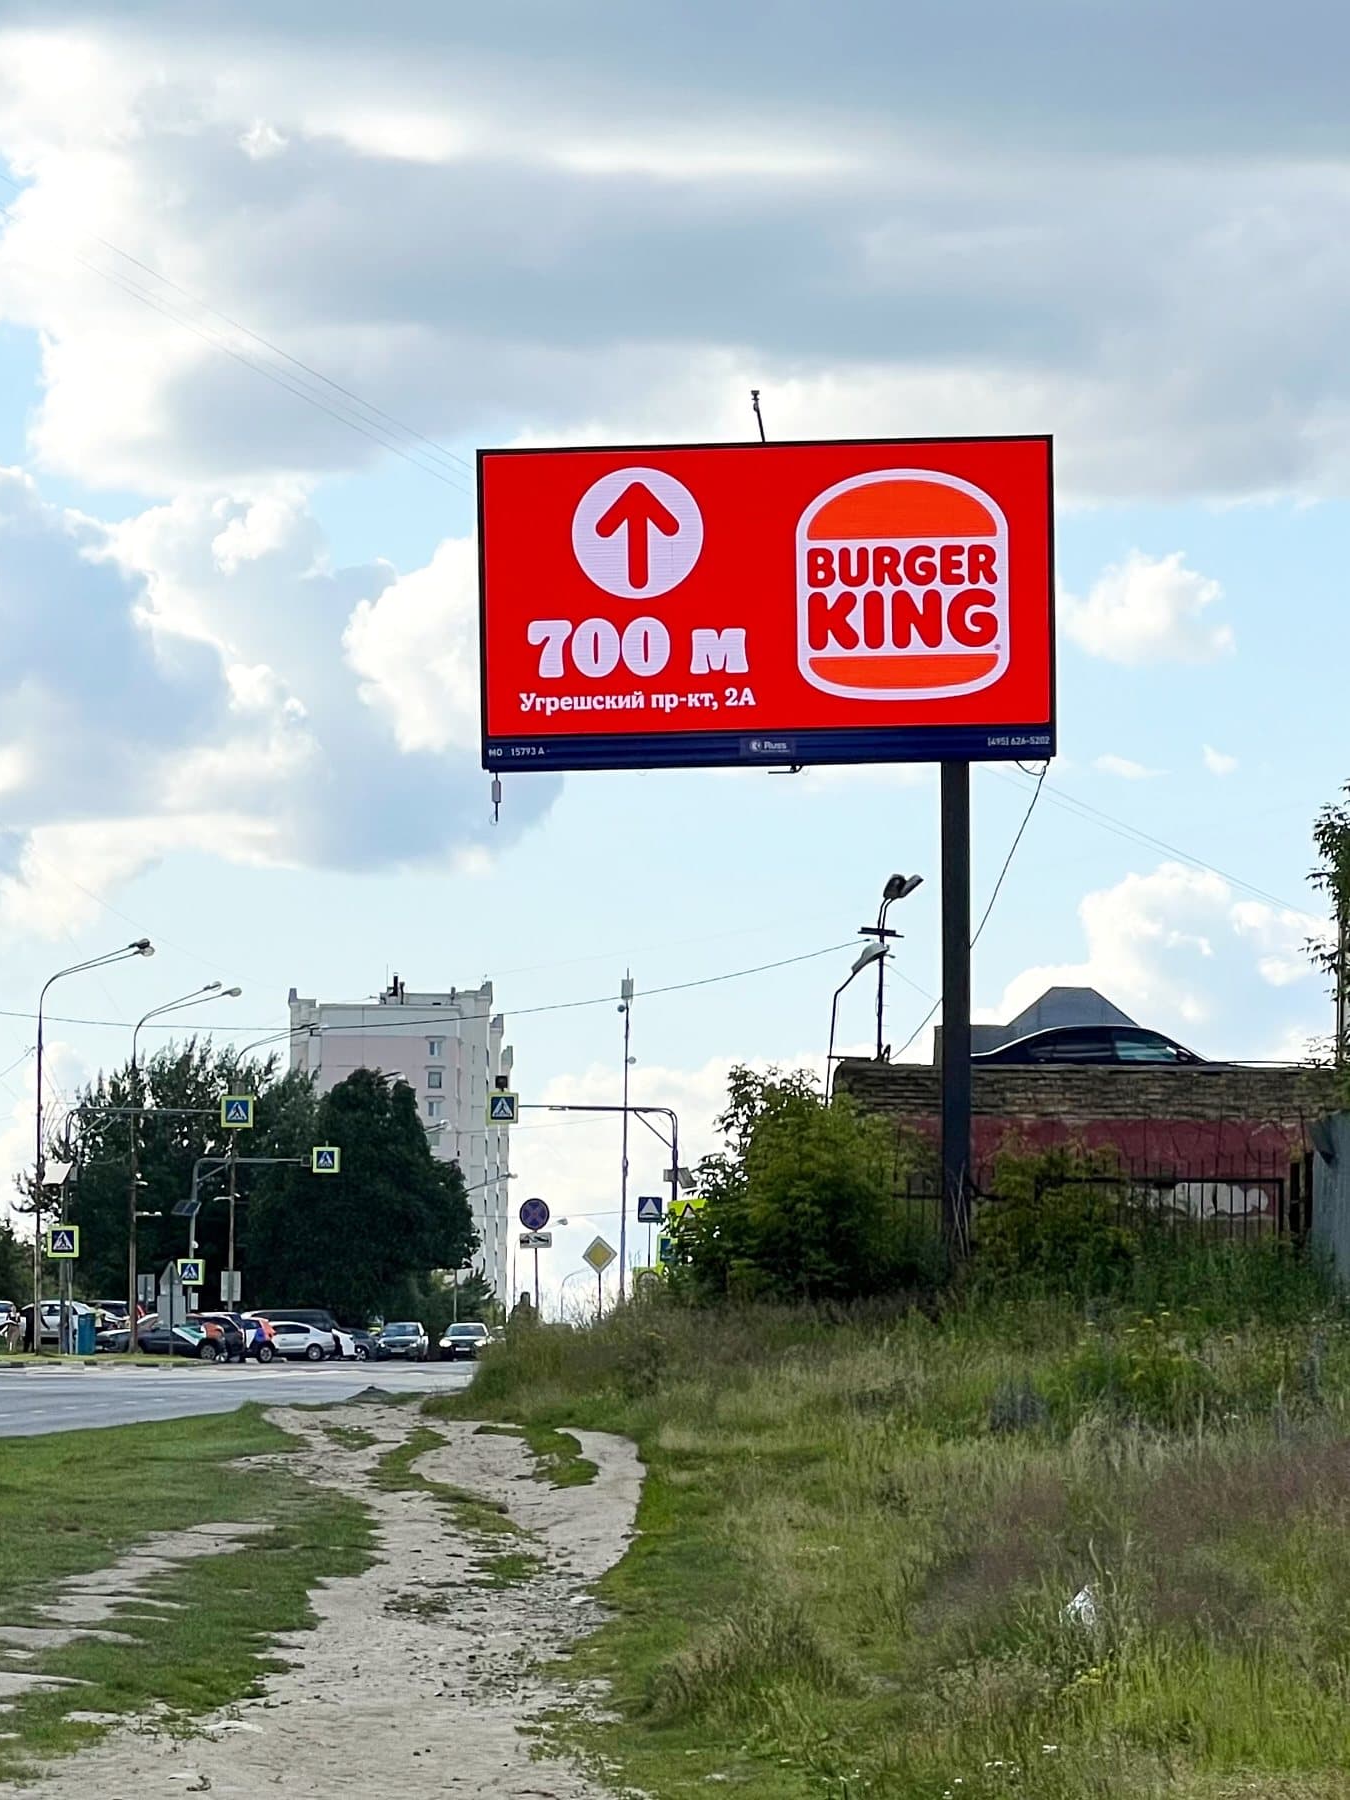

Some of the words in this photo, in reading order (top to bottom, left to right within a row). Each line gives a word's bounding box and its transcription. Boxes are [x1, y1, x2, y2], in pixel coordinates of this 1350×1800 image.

[807, 544, 998, 588] BURGER
[808, 588, 999, 651] KING
[527, 616, 671, 678] 700
[690, 627, 749, 675] м
[519, 691, 645, 715] Угрешский
[651, 692, 719, 712] пр-кт,
[725, 688, 756, 707] 2А
